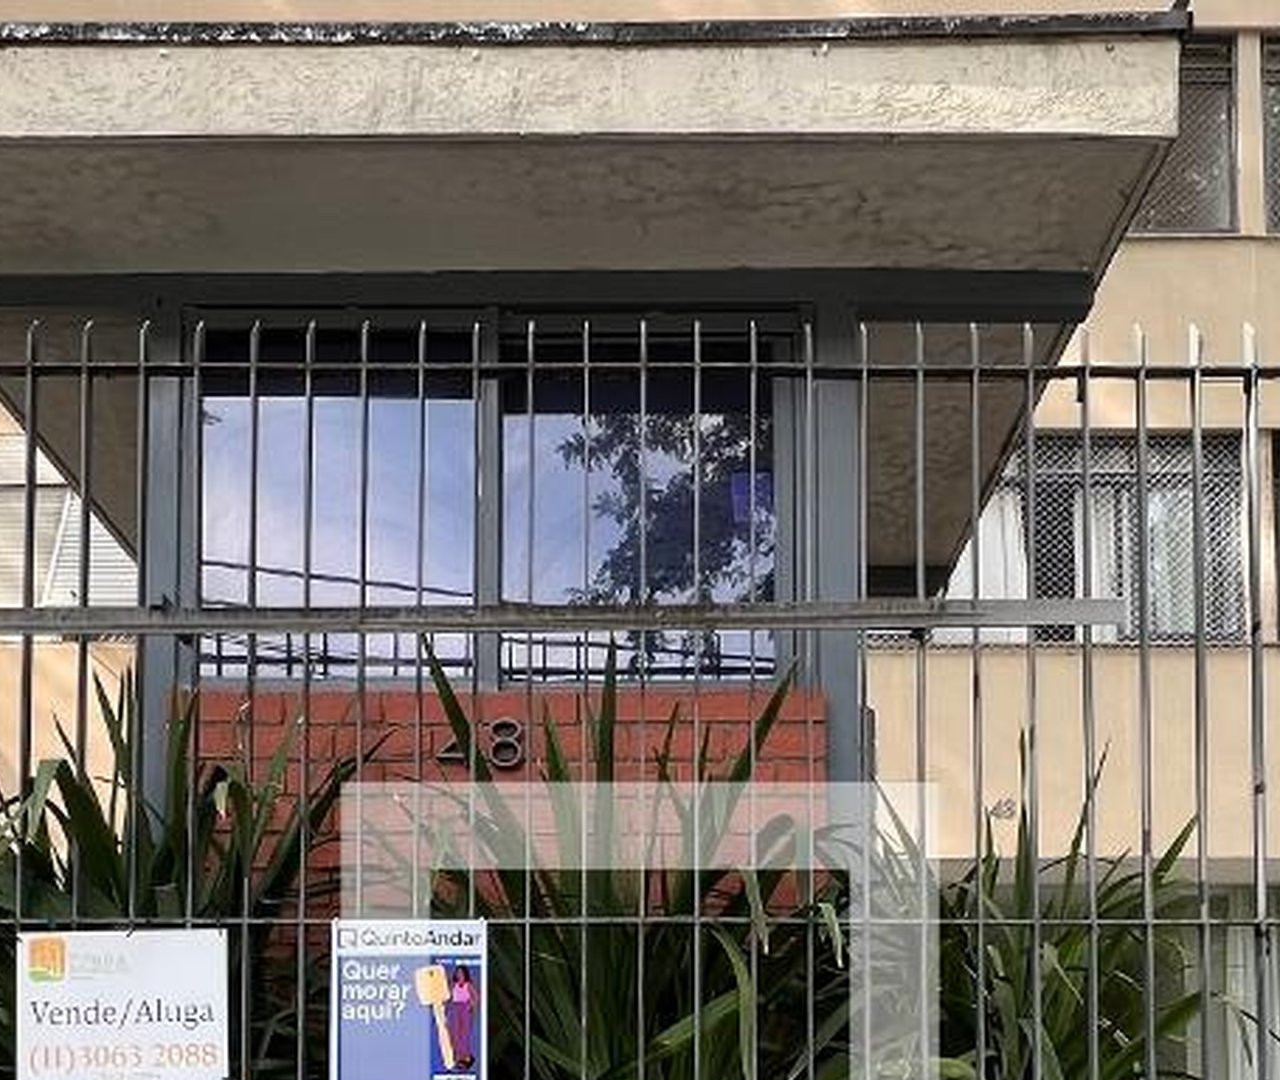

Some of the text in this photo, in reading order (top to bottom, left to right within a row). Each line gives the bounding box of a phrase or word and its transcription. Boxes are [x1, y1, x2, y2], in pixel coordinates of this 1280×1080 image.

[361, 929, 481, 947] QuintoAndar
[342, 960, 401, 981] Quer
[342, 984, 411, 1000] morar
[30, 998, 217, 1031] Vende/Aluga
[342, 1001, 406, 1024] aqui?
